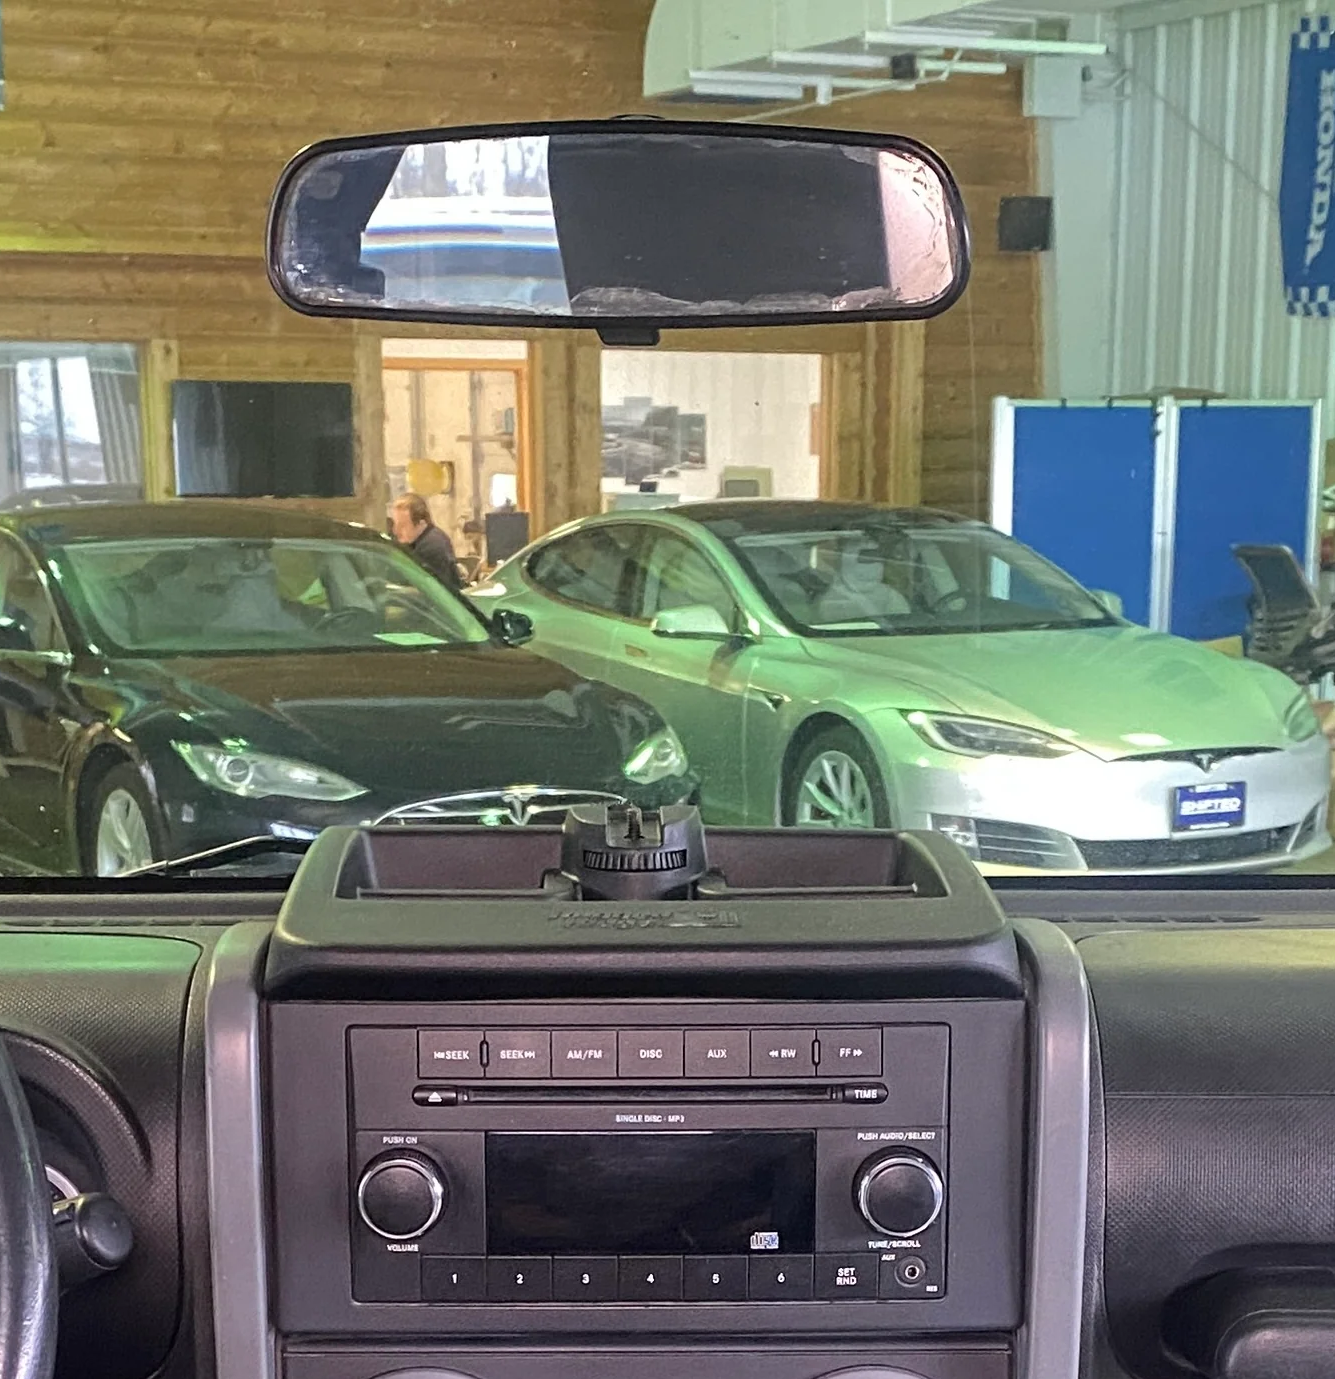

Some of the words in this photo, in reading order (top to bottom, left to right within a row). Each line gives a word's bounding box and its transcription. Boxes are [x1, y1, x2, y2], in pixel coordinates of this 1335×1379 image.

[445, 1050, 470, 1060] SEEK
[500, 1050, 524, 1060] SEEK
[567, 1049, 603, 1061] AM/FM
[639, 1049, 663, 1059] DISC
[707, 1049, 727, 1059] AUX
[780, 1048, 797, 1059] RW
[839, 1047, 852, 1058] FF
[854, 1088, 878, 1100] TIME
[382, 1136, 404, 1144] PUSH
[405, 1136, 418, 1144] ON
[857, 1132, 878, 1141] PUSH
[879, 1131, 936, 1141] AUDIO/SELECT
[386, 1243, 419, 1252] VOLUME
[867, 1239, 922, 1249] TUNE/SCROLL
[837, 1267, 856, 1277] SET
[451, 1273, 458, 1284] 1
[515, 1273, 524, 1284] 2
[581, 1273, 590, 1284] 3
[646, 1273, 655, 1284] 4
[711, 1273, 720, 1284] 5
[777, 1272, 786, 1283] 6
[836, 1276, 857, 1286] RND
